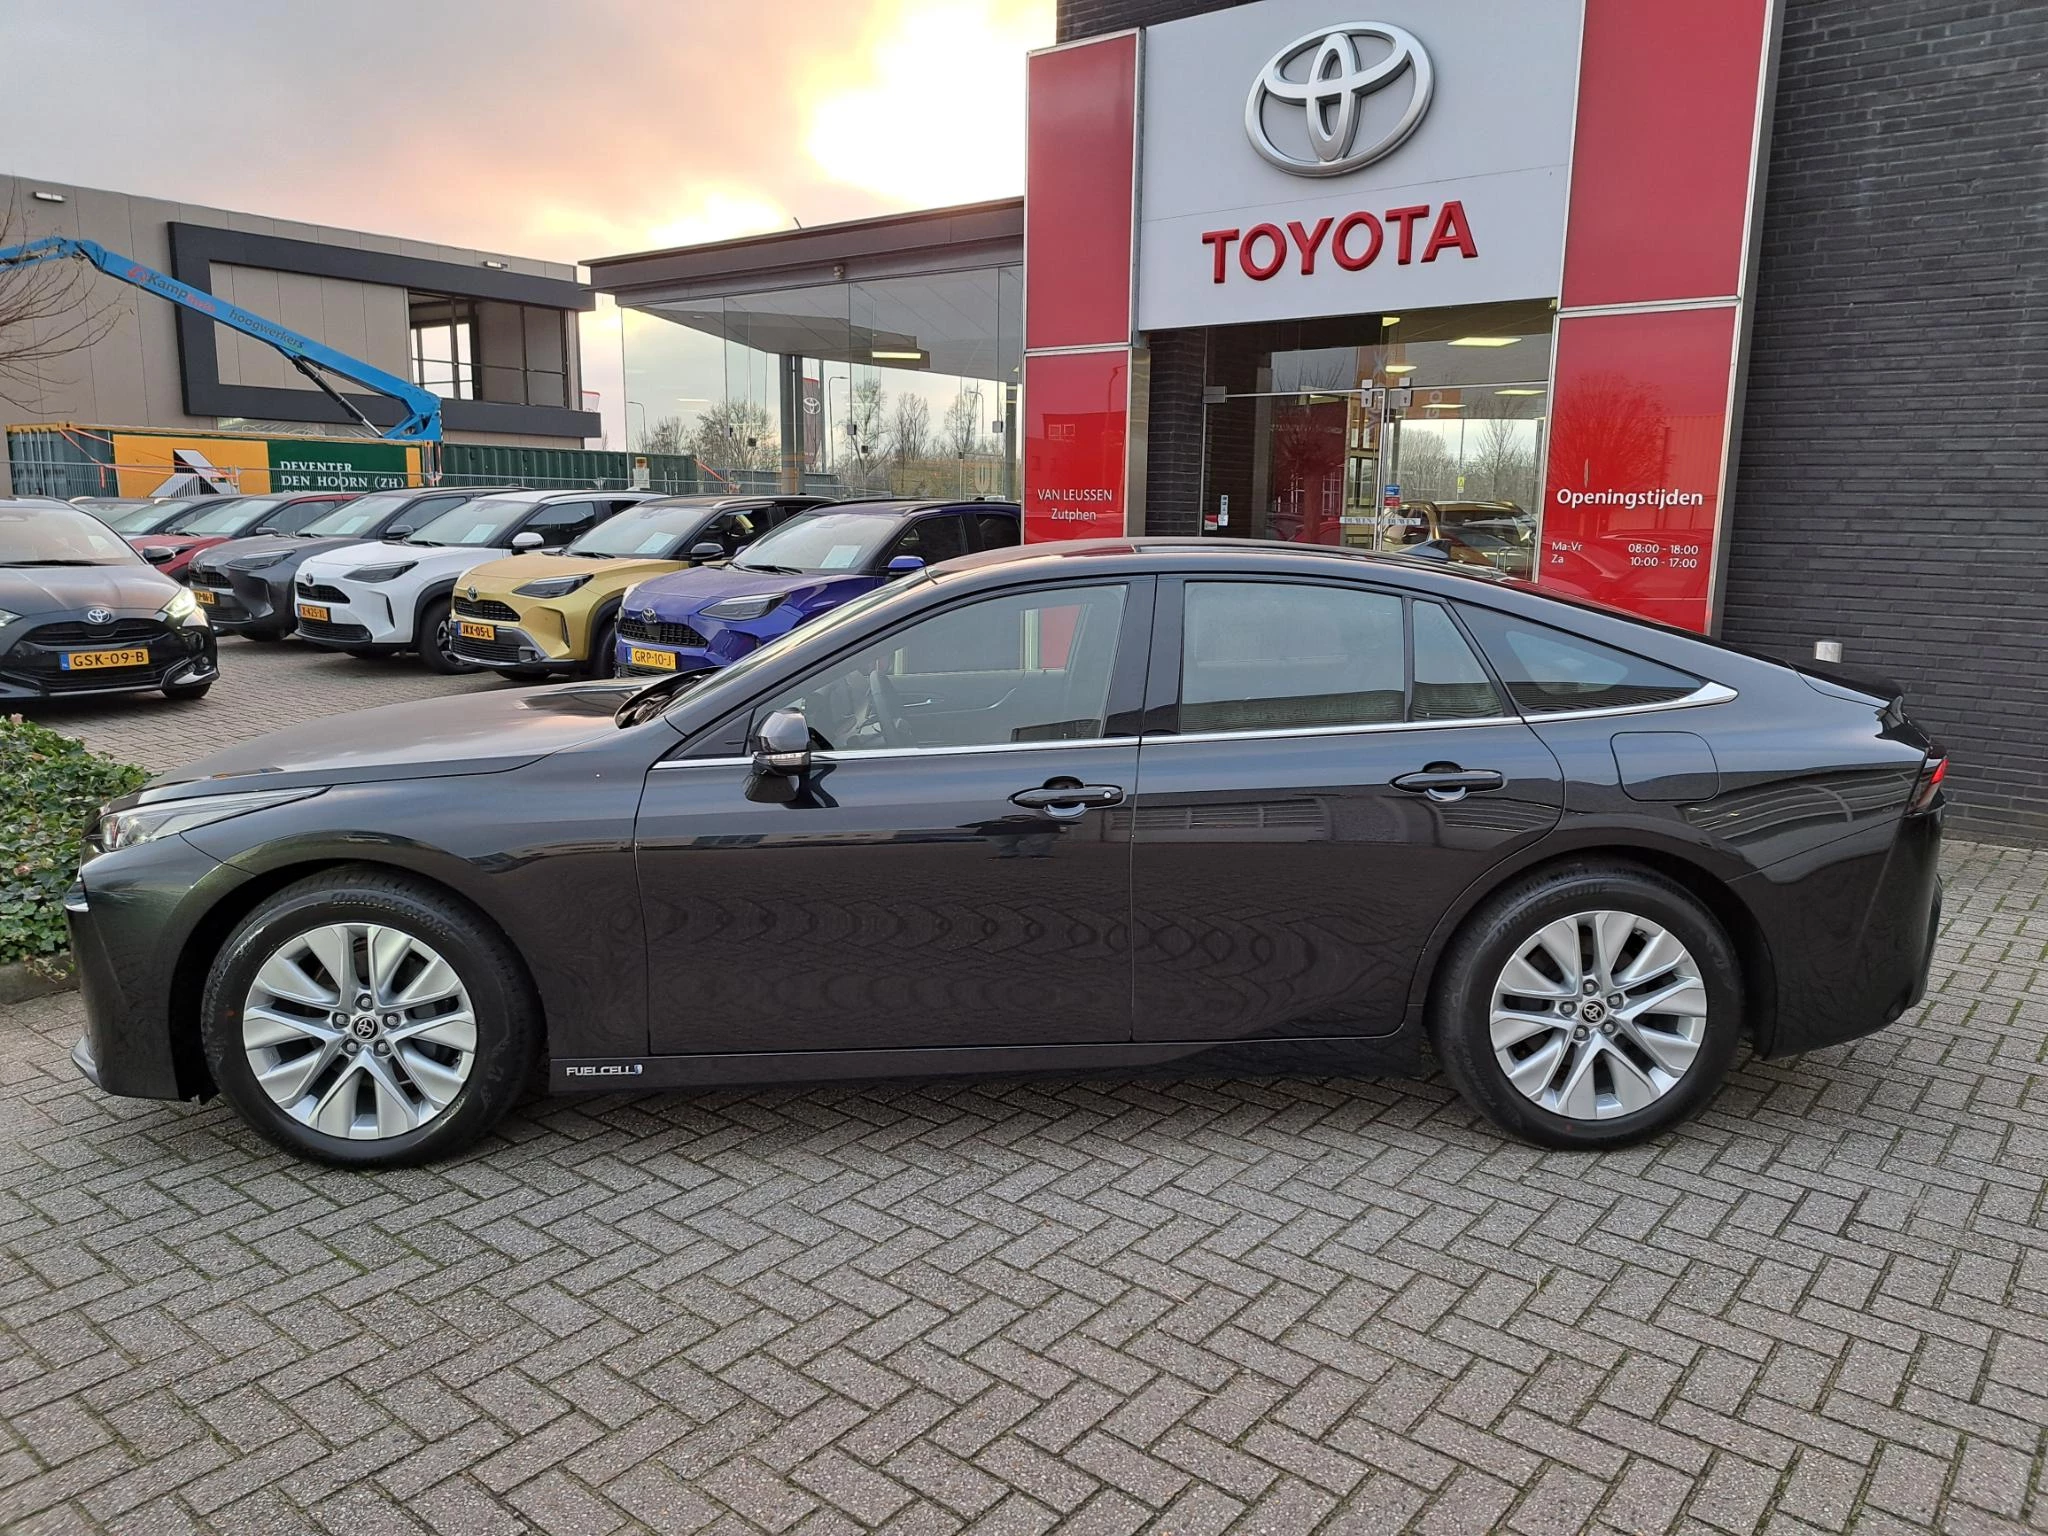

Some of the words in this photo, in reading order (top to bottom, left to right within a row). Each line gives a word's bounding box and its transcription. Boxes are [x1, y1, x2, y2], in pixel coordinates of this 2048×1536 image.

[1202, 200, 1478, 284] TOYOTA
[229, 309, 305, 349] hoogwerkers
[280, 461, 352, 472] DEVENTER
[281, 475, 310, 487] DEN
[318, 475, 368, 488] HOORN
[374, 476, 404, 489] (ZH)
[1037, 488, 1060, 501] VAN
[1063, 489, 1113, 501] LEUSSEN
[1556, 488, 1704, 509] Openingstijden
[1051, 508, 1096, 523] Zutphen
[1551, 541, 1583, 551] Ma-Vr
[1628, 543, 1659, 554] 08:00
[1670, 545, 1699, 555] 18:00
[1551, 554, 1564, 564] Za
[1630, 556, 1659, 567] 10:00
[1669, 558, 1697, 568] 17:00
[462, 624, 492, 638] JKX-05-L
[73, 651, 145, 667] GSK-09-B
[635, 650, 672, 666] GRP-10-J
